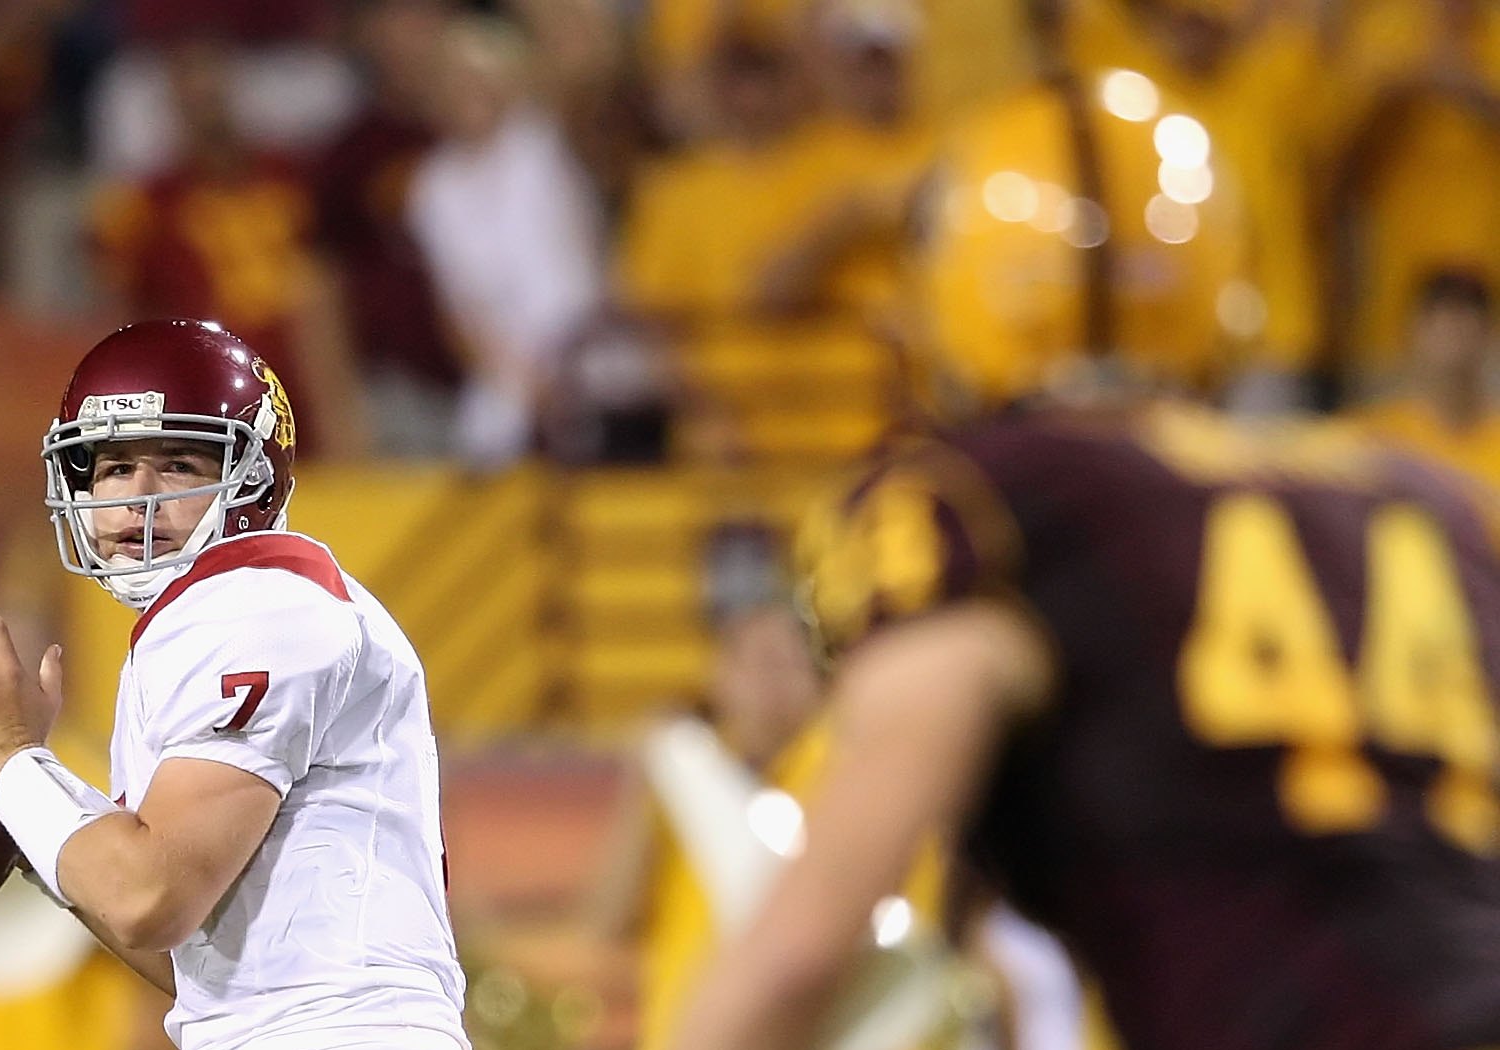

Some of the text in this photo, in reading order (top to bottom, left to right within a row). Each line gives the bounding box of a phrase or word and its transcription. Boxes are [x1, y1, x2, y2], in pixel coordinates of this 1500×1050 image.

[102, 398, 142, 411] USC
[212, 671, 269, 733] 7
[1175, 495, 1500, 857] 44
